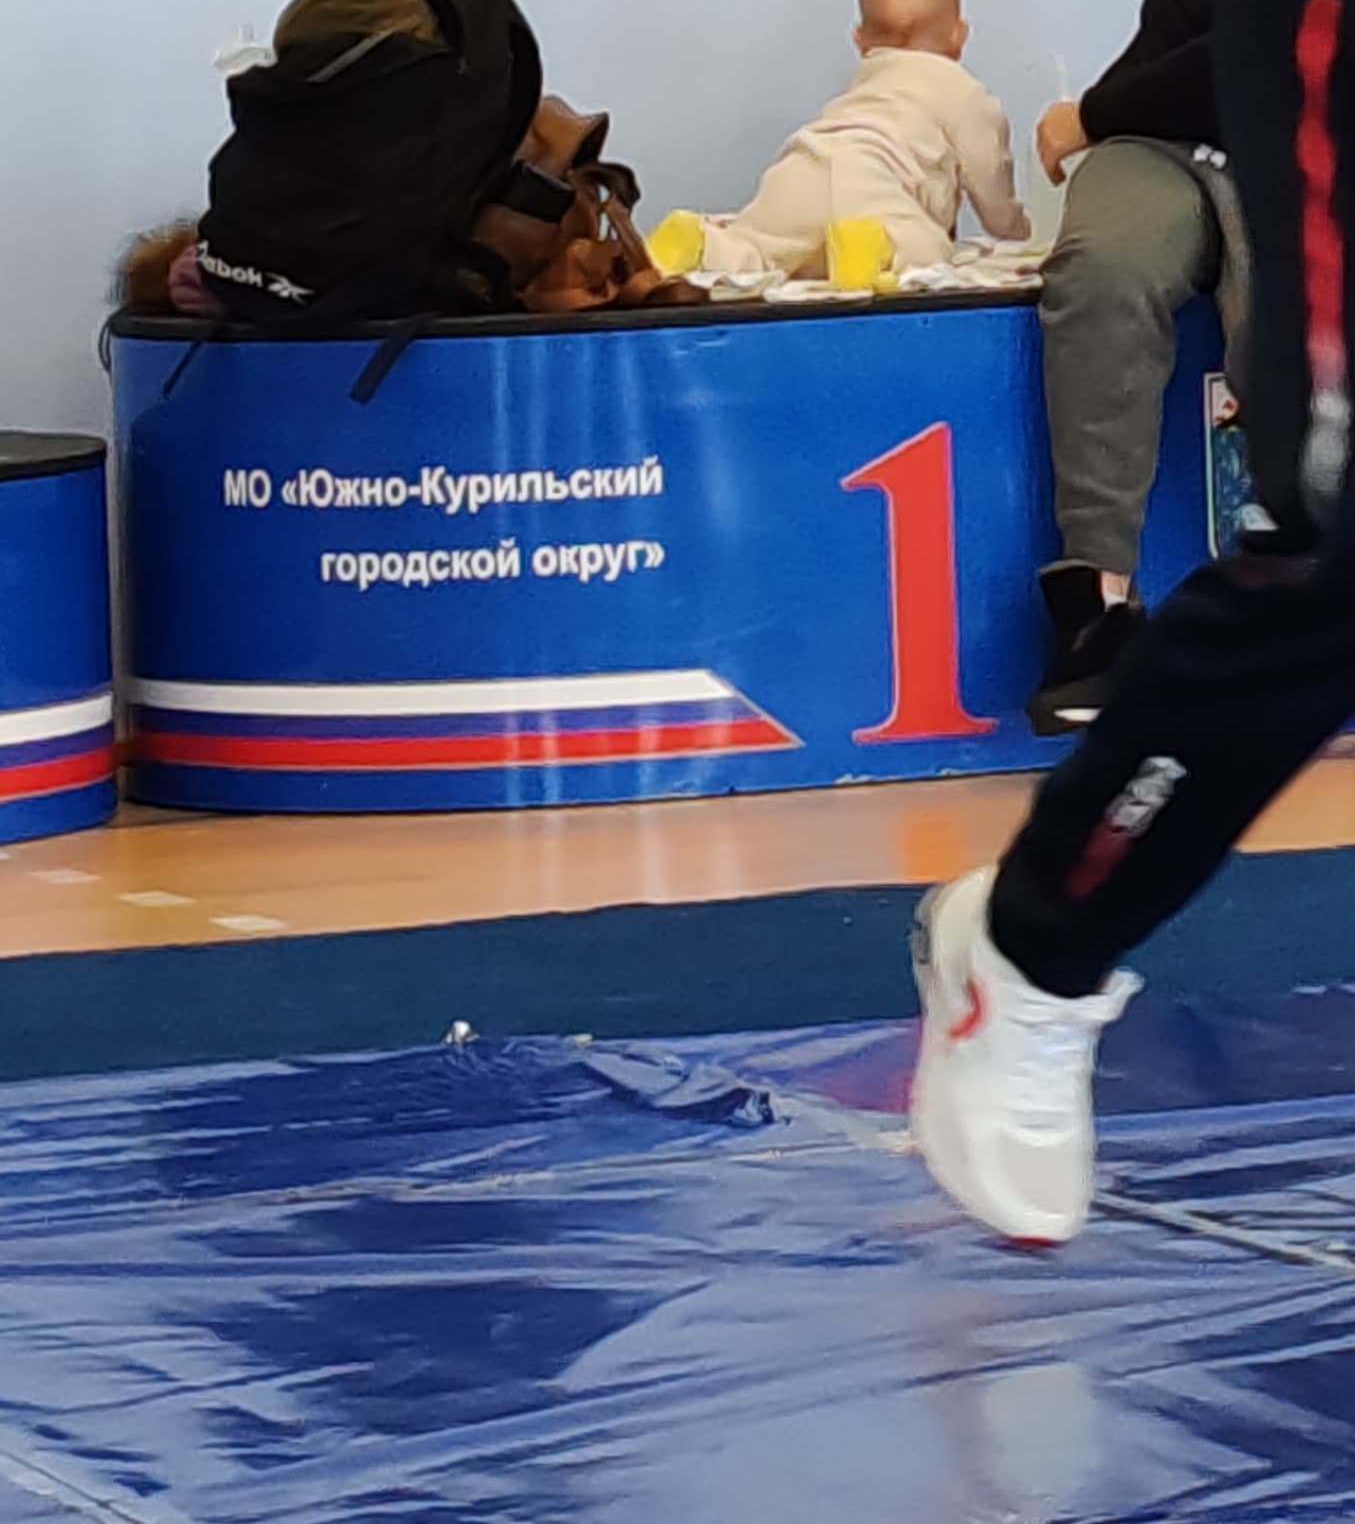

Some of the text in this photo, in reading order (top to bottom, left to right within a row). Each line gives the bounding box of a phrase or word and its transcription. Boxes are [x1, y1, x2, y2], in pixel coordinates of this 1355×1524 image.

[224, 455, 664, 515] МО «Южно-Курильский
[321, 537, 666, 591] городской округ»
[840, 420, 999, 745] 1
